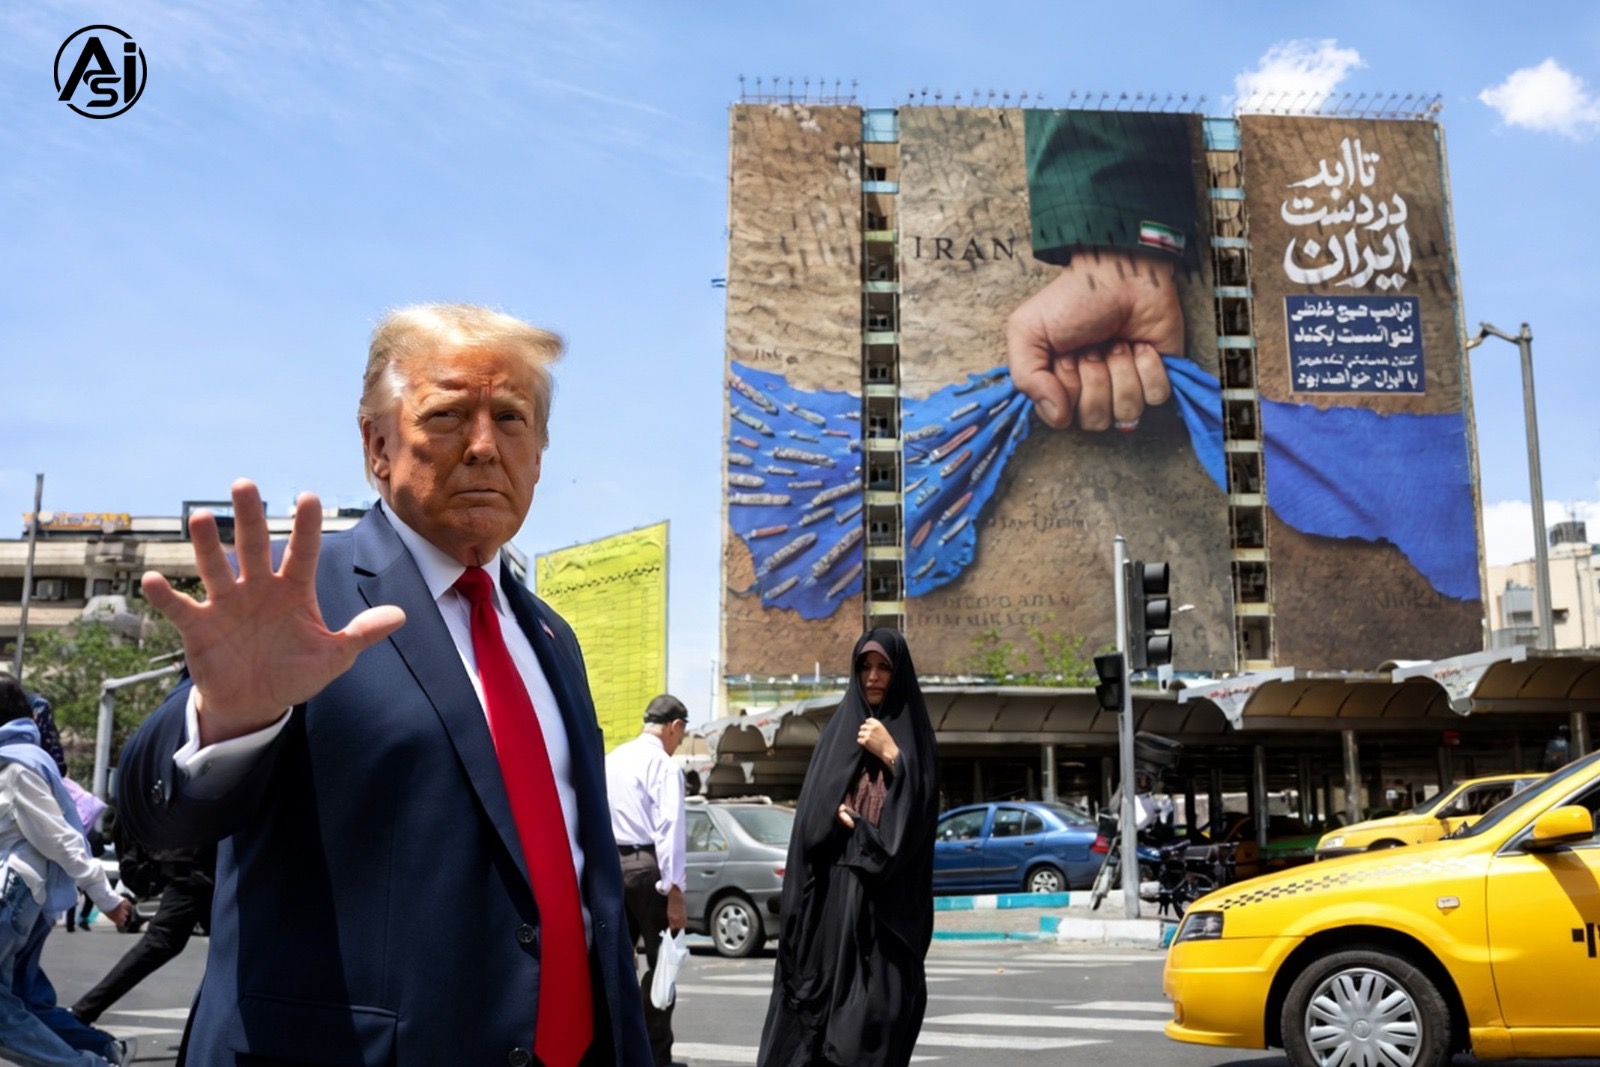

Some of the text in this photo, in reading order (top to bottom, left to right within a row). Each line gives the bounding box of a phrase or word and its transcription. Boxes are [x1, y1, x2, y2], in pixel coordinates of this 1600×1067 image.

[1286, 136, 1380, 200] تا ابد
[1281, 192, 1408, 232] در دست
[911, 235, 1015, 261] IRAN
[1283, 223, 1412, 292] ایران
